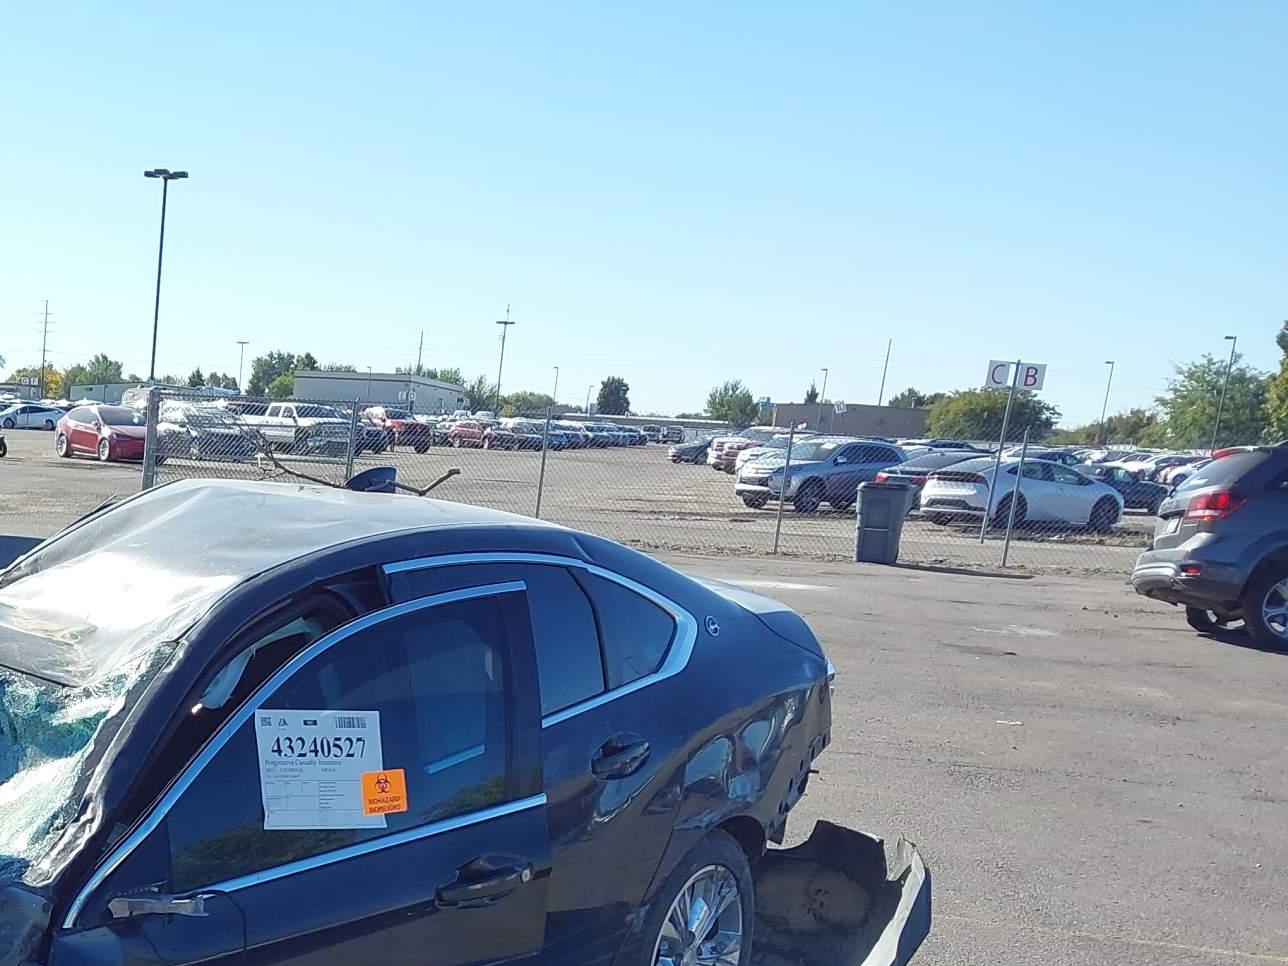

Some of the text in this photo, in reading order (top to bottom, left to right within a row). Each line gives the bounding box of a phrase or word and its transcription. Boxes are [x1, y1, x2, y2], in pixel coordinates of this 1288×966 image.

[991, 364, 1006, 384] C
[1024, 366, 1038, 386] B
[271, 735, 366, 759] 43240527
